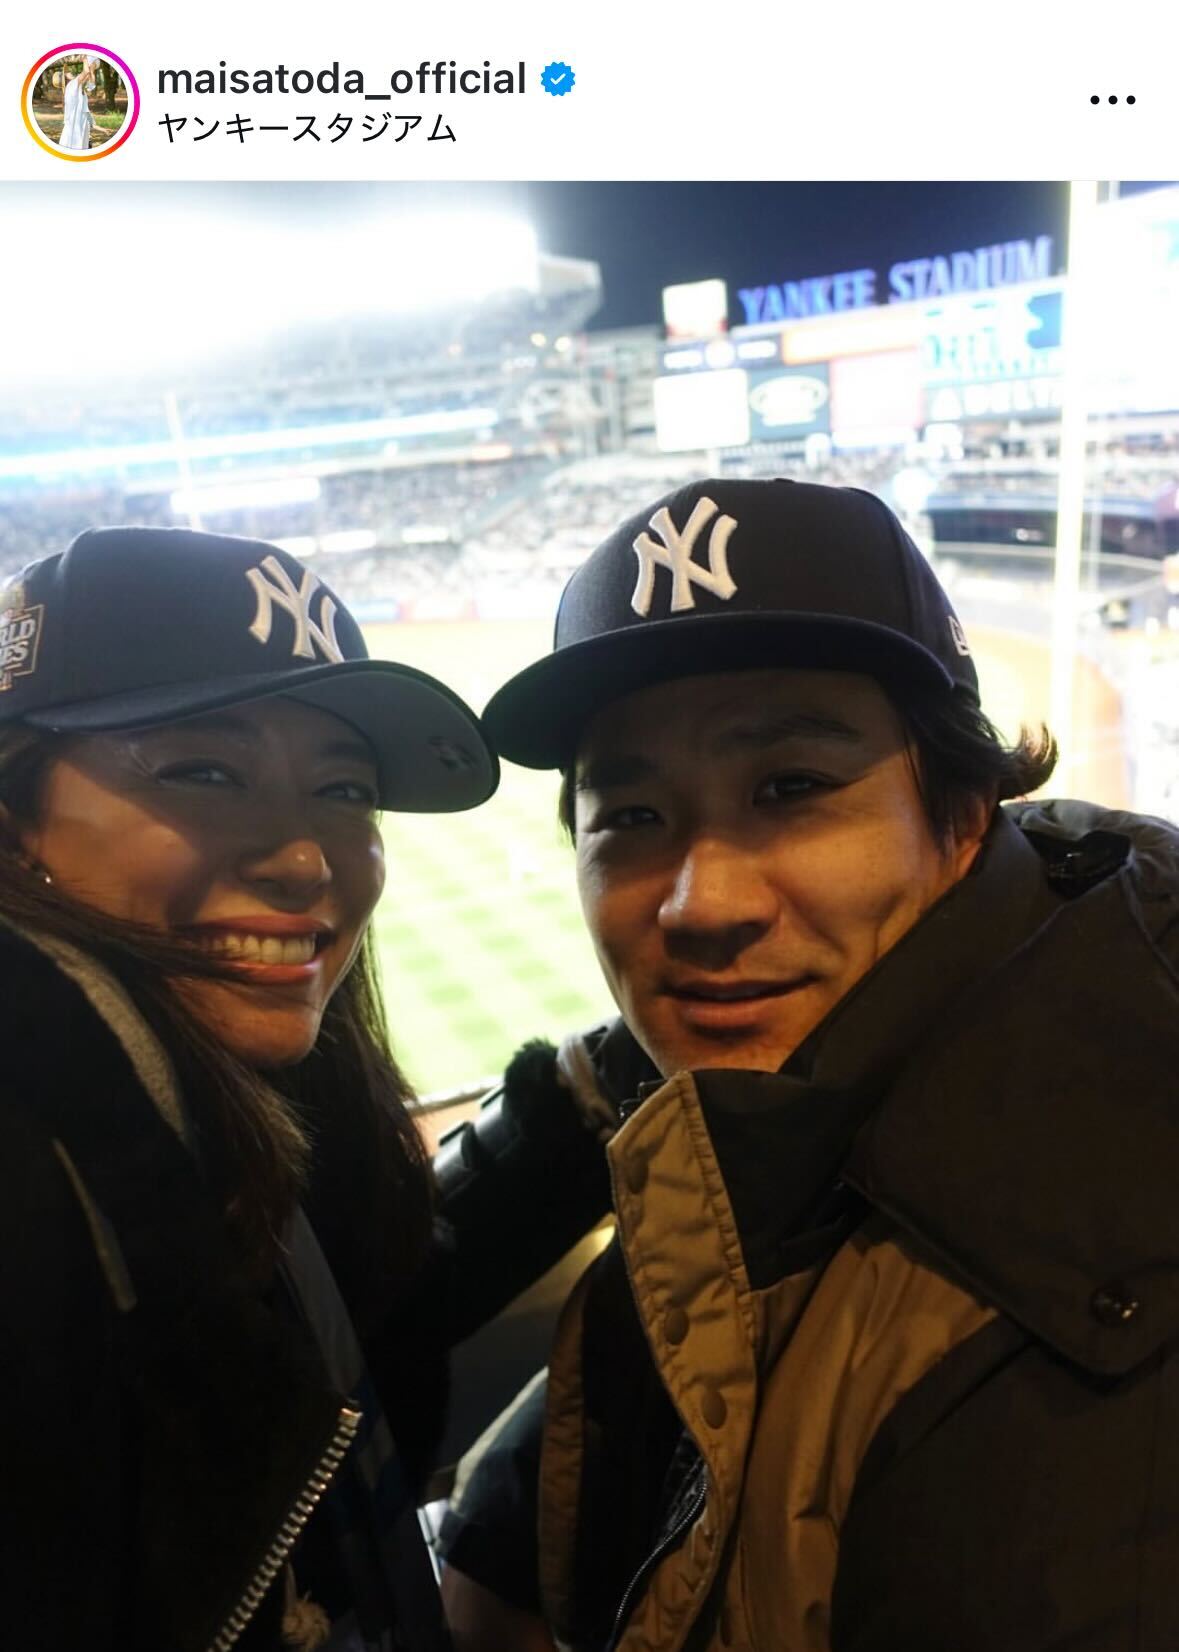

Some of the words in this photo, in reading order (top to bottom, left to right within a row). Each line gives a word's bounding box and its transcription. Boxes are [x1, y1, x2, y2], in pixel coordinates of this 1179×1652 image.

[738, 269, 876, 325] YANKEE
[889, 236, 1053, 303] STADIUM
[246, 555, 345, 664] NY
[631, 496, 738, 617] NY
